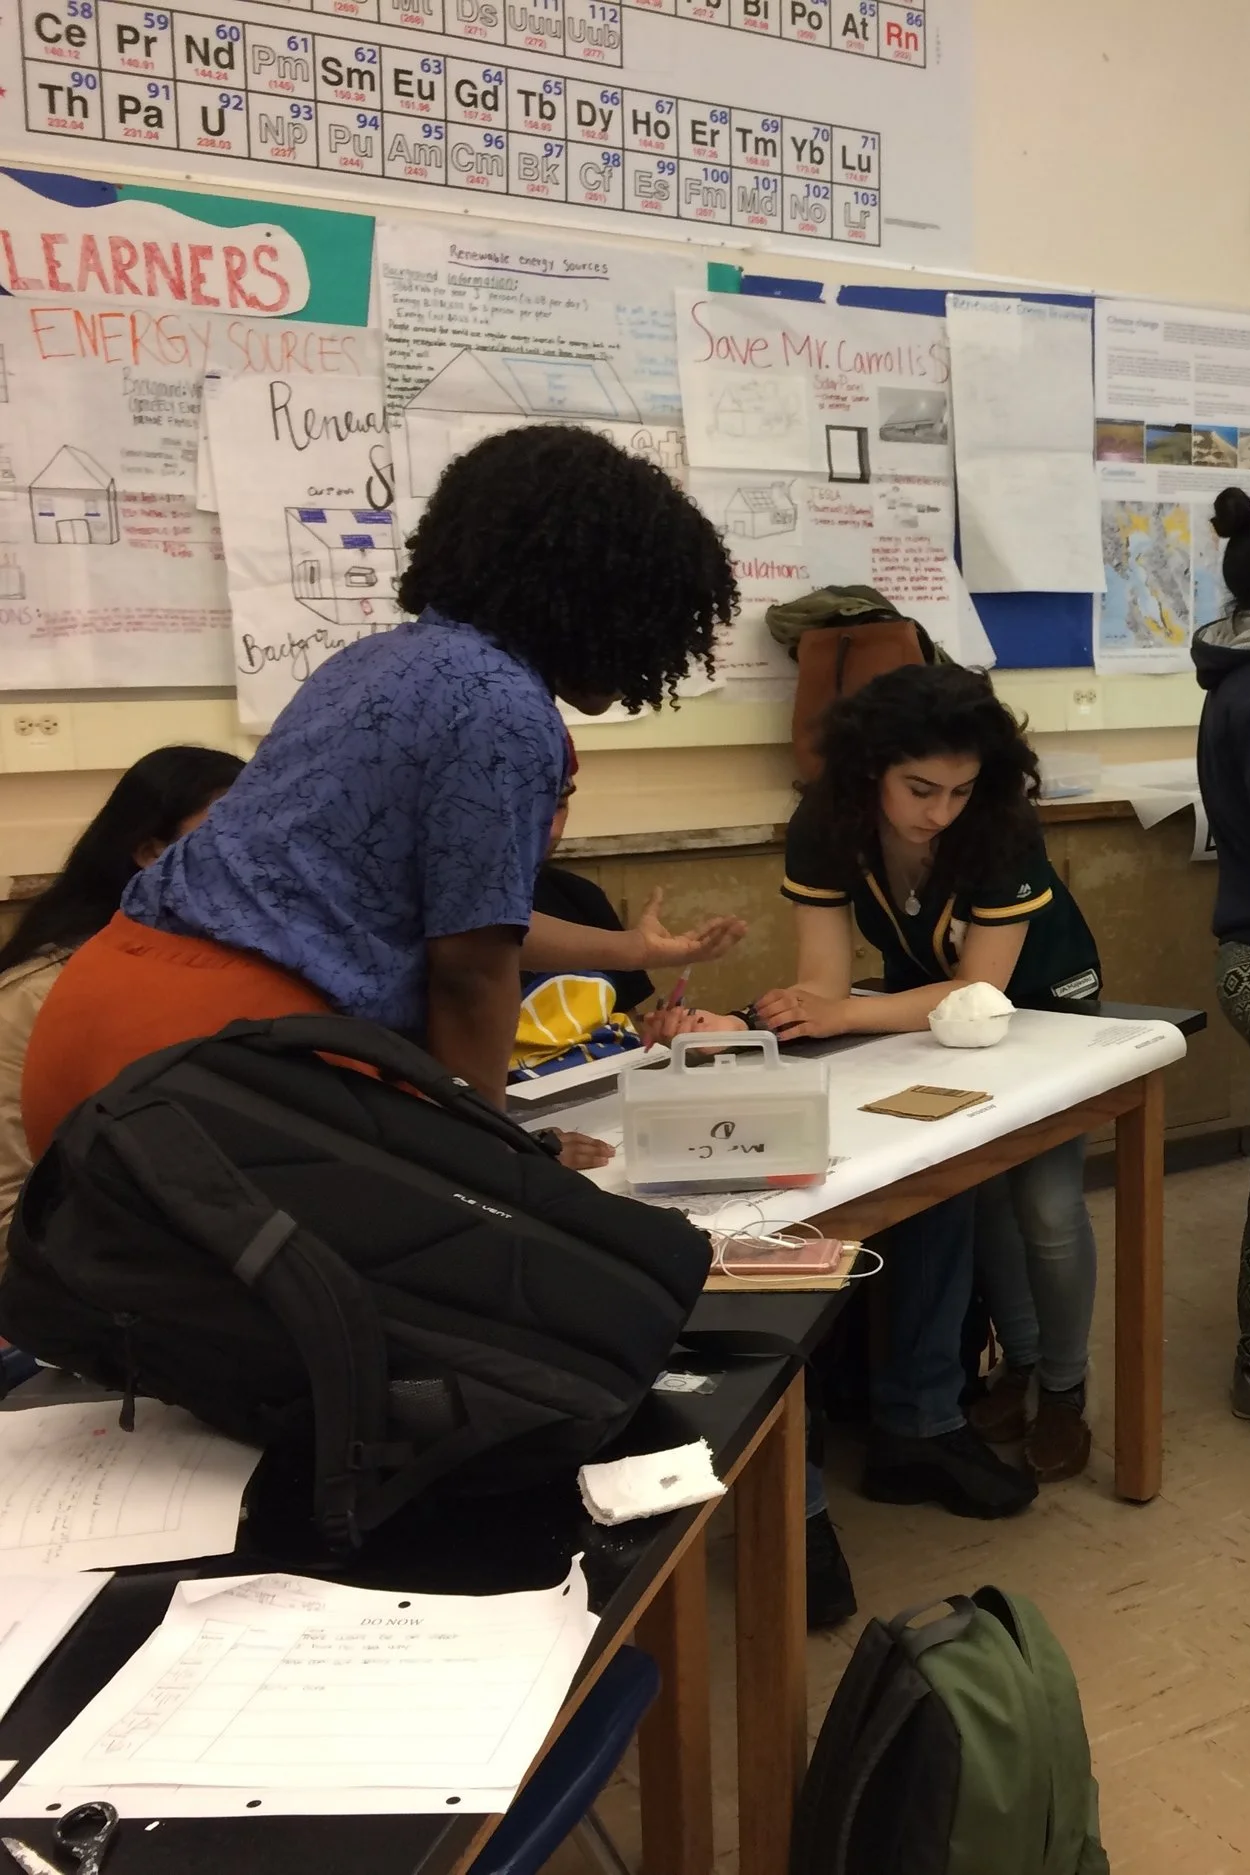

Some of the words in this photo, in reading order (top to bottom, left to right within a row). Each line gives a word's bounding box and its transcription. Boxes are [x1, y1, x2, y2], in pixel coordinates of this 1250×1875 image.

[67, 0, 92, 19] 58
[144, 12, 168, 30] 59
[508, 5, 561, 38] Uuu
[589, 5, 618, 23] 112
[791, 1, 822, 30] Po
[860, 2, 875, 17] 85
[906, 12, 922, 27] 86
[35, 12, 86, 47] Ce
[117, 24, 157, 57] Pr
[216, 24, 240, 42] 60
[568, 17, 620, 49] Uub
[842, 13, 868, 41] At
[887, 22, 918, 51] Rn
[185, 35, 235, 69] Nd
[287, 36, 308, 52] 61
[355, 47, 377, 64] 62
[252, 44, 309, 82] Pm
[321, 56, 375, 91] Sm
[420, 58, 442, 75] 63
[71, 71, 97, 90] 90
[393, 69, 435, 102] Eu
[482, 69, 503, 85] 64
[542, 80, 562, 96] 65
[38, 83, 88, 118] Th
[147, 83, 170, 100] 91
[219, 92, 243, 111] 92
[455, 79, 499, 111] Gd
[517, 89, 556, 121] Tb
[600, 90, 620, 106] 66
[118, 94, 164, 129] Pa
[201, 106, 225, 136] U
[290, 103, 313, 120] 93
[576, 99, 613, 132] Dy
[655, 100, 674, 115] 67
[710, 109, 728, 125] 68
[258, 113, 308, 148] Np
[356, 114, 379, 130] 94
[421, 123, 444, 141] 95
[632, 109, 670, 139] Ho
[691, 120, 720, 147] Er
[761, 118, 779, 133] 69
[812, 127, 829, 142] 70
[329, 124, 373, 158] Pu
[388, 133, 443, 168] Am
[483, 133, 505, 150] 96
[544, 143, 564, 158] 97
[735, 127, 776, 158] Tm
[790, 136, 824, 165] Yb
[861, 135, 876, 150] 71
[451, 142, 503, 177] Cm
[518, 152, 560, 185] Bk
[601, 152, 621, 168] 98
[657, 160, 676, 176] 99
[841, 145, 871, 173] Lu
[579, 162, 613, 192] Cf
[634, 170, 670, 201] Es
[702, 168, 729, 184] 100
[754, 176, 778, 192] 101
[685, 178, 726, 209] Fm
[737, 186, 777, 216] Md
[805, 184, 829, 200] 102
[854, 191, 877, 207] 103
[790, 194, 826, 223] No
[844, 202, 870, 229] Lr
[0, 229, 291, 313] LEARNERS
[449, 244, 510, 266] Renewable
[518, 254, 555, 272] energy
[30, 307, 212, 369] ENERGY
[693, 300, 772, 369] Save
[782, 331, 830, 370] Mr.
[731, 557, 810, 580] culations
[360, 1618, 383, 1626] DO
[385, 1618, 425, 1626] NOW
